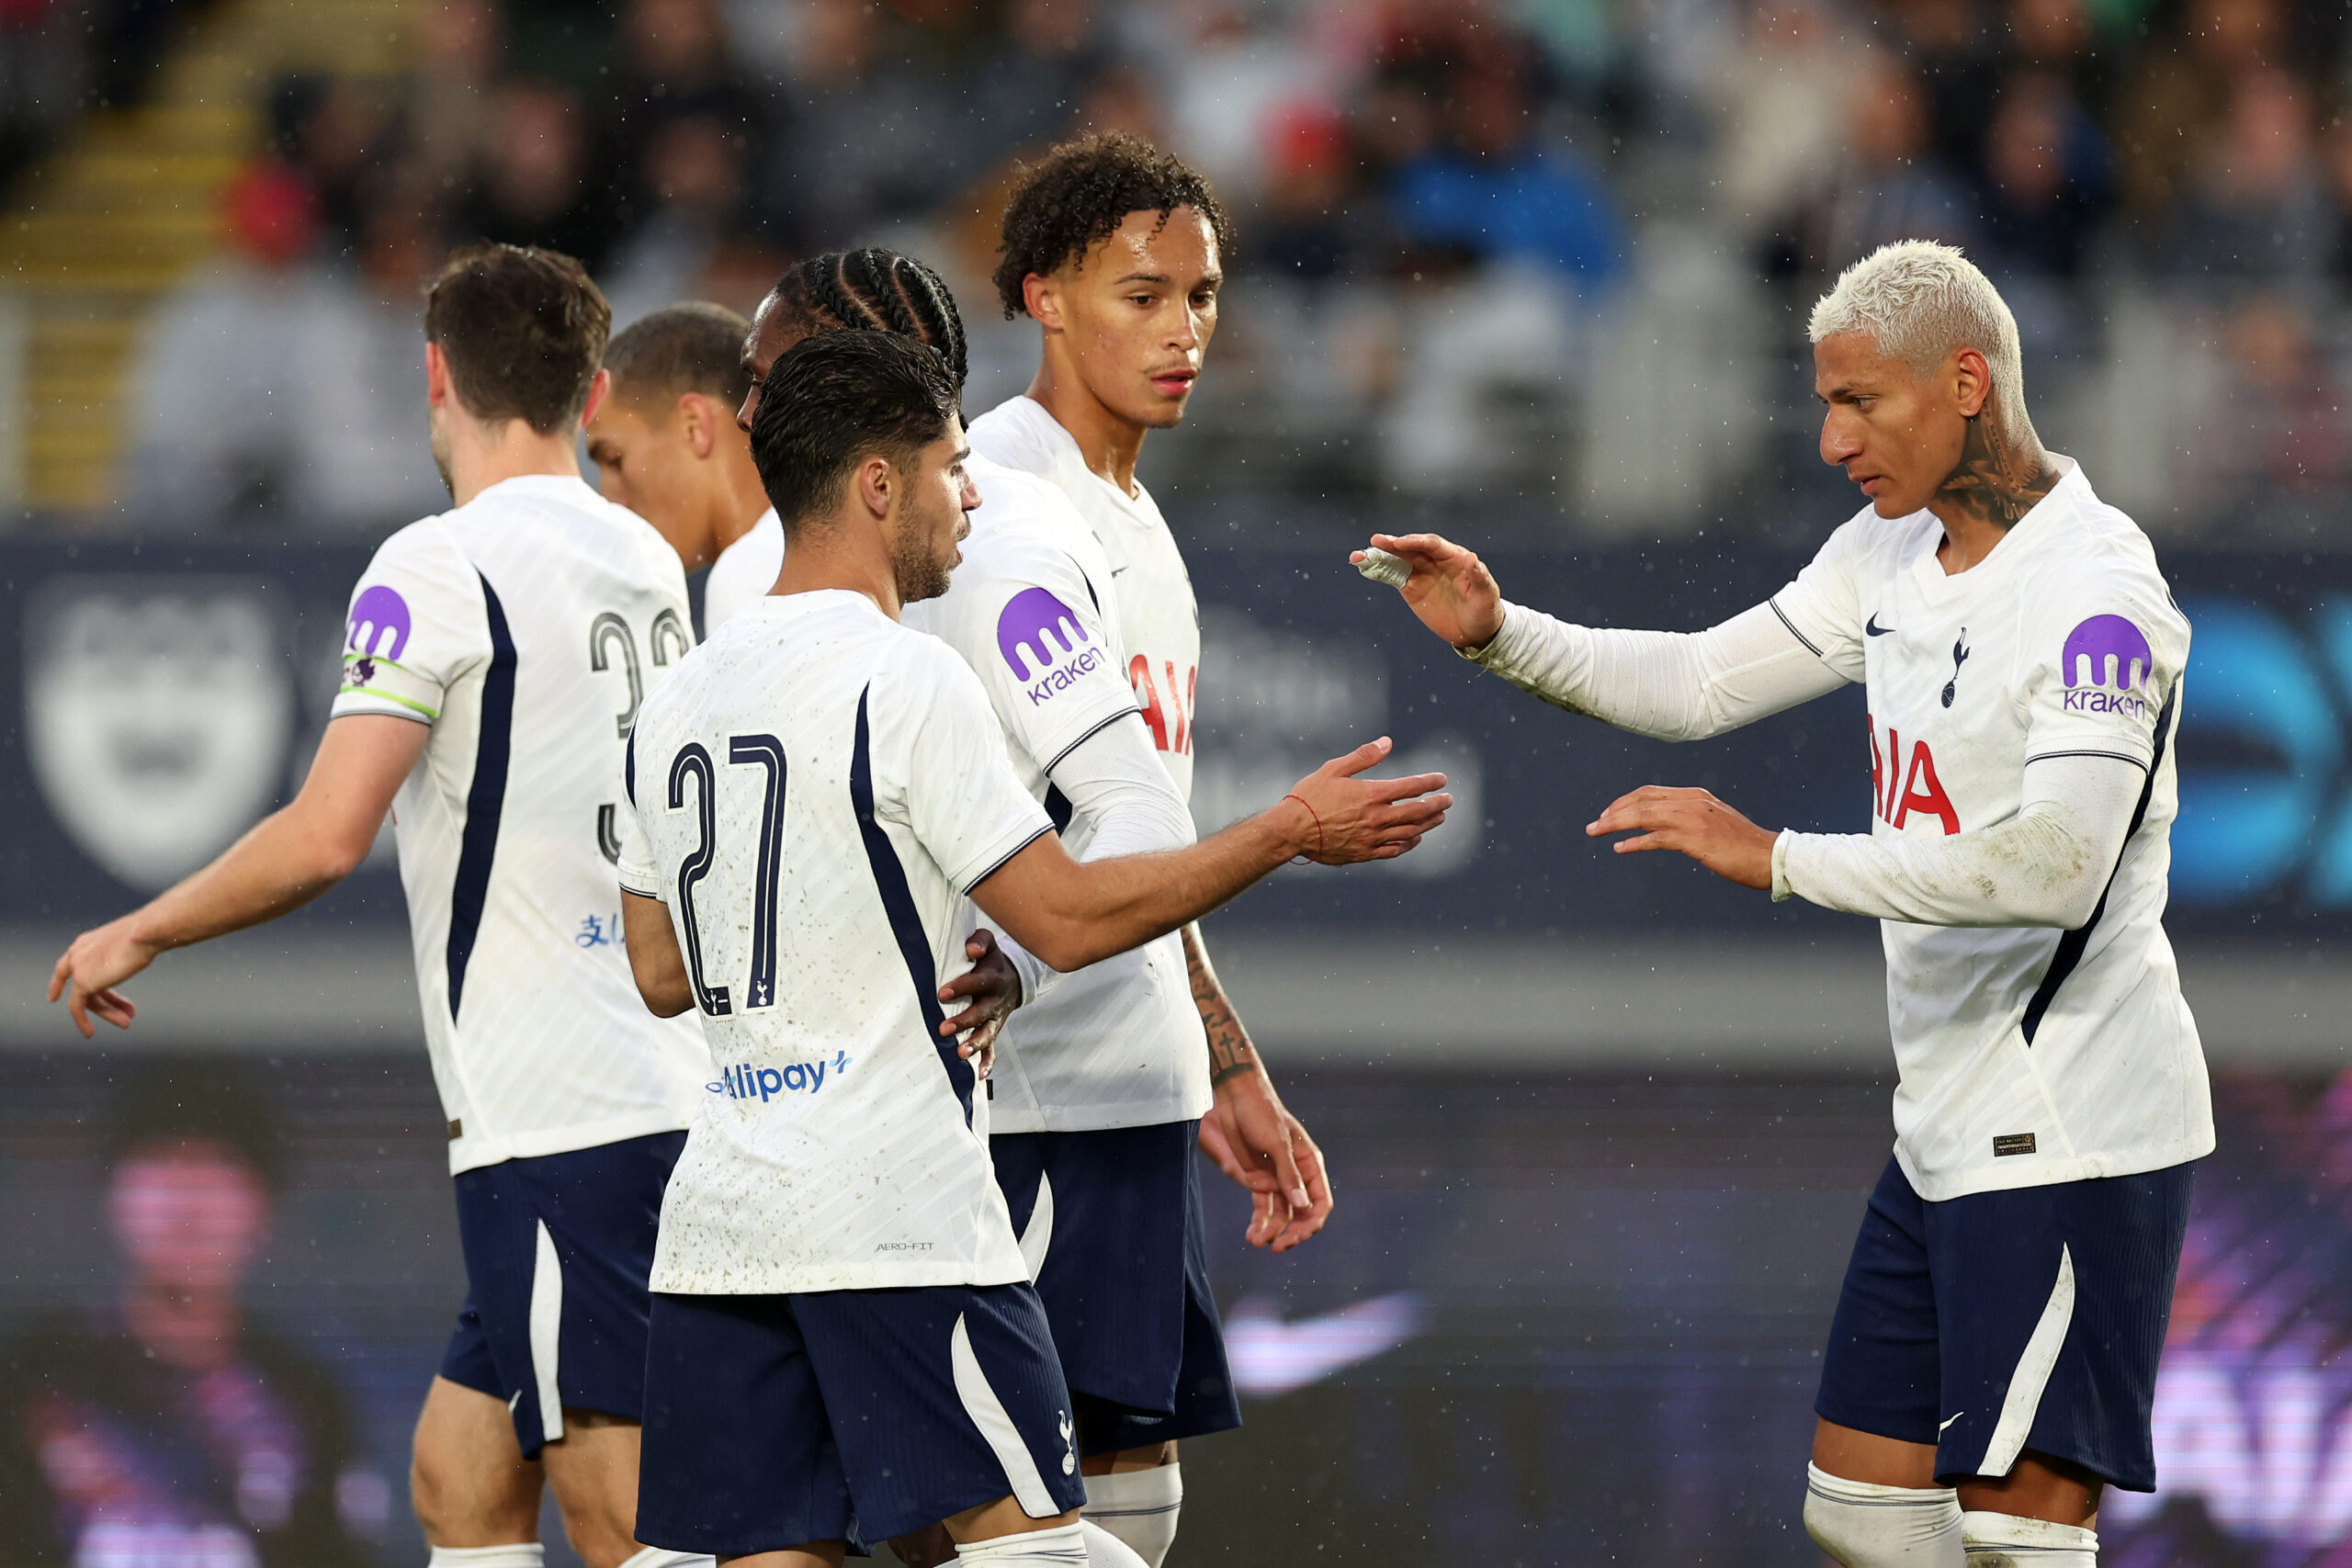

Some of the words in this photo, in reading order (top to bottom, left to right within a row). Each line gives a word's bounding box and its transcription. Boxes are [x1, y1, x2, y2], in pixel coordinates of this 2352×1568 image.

[1026, 647, 1106, 707] kraken
[2064, 690, 2145, 721] kraken
[668, 733, 787, 1017] 27
[876, 1242, 934, 1251] AERO-FIT
